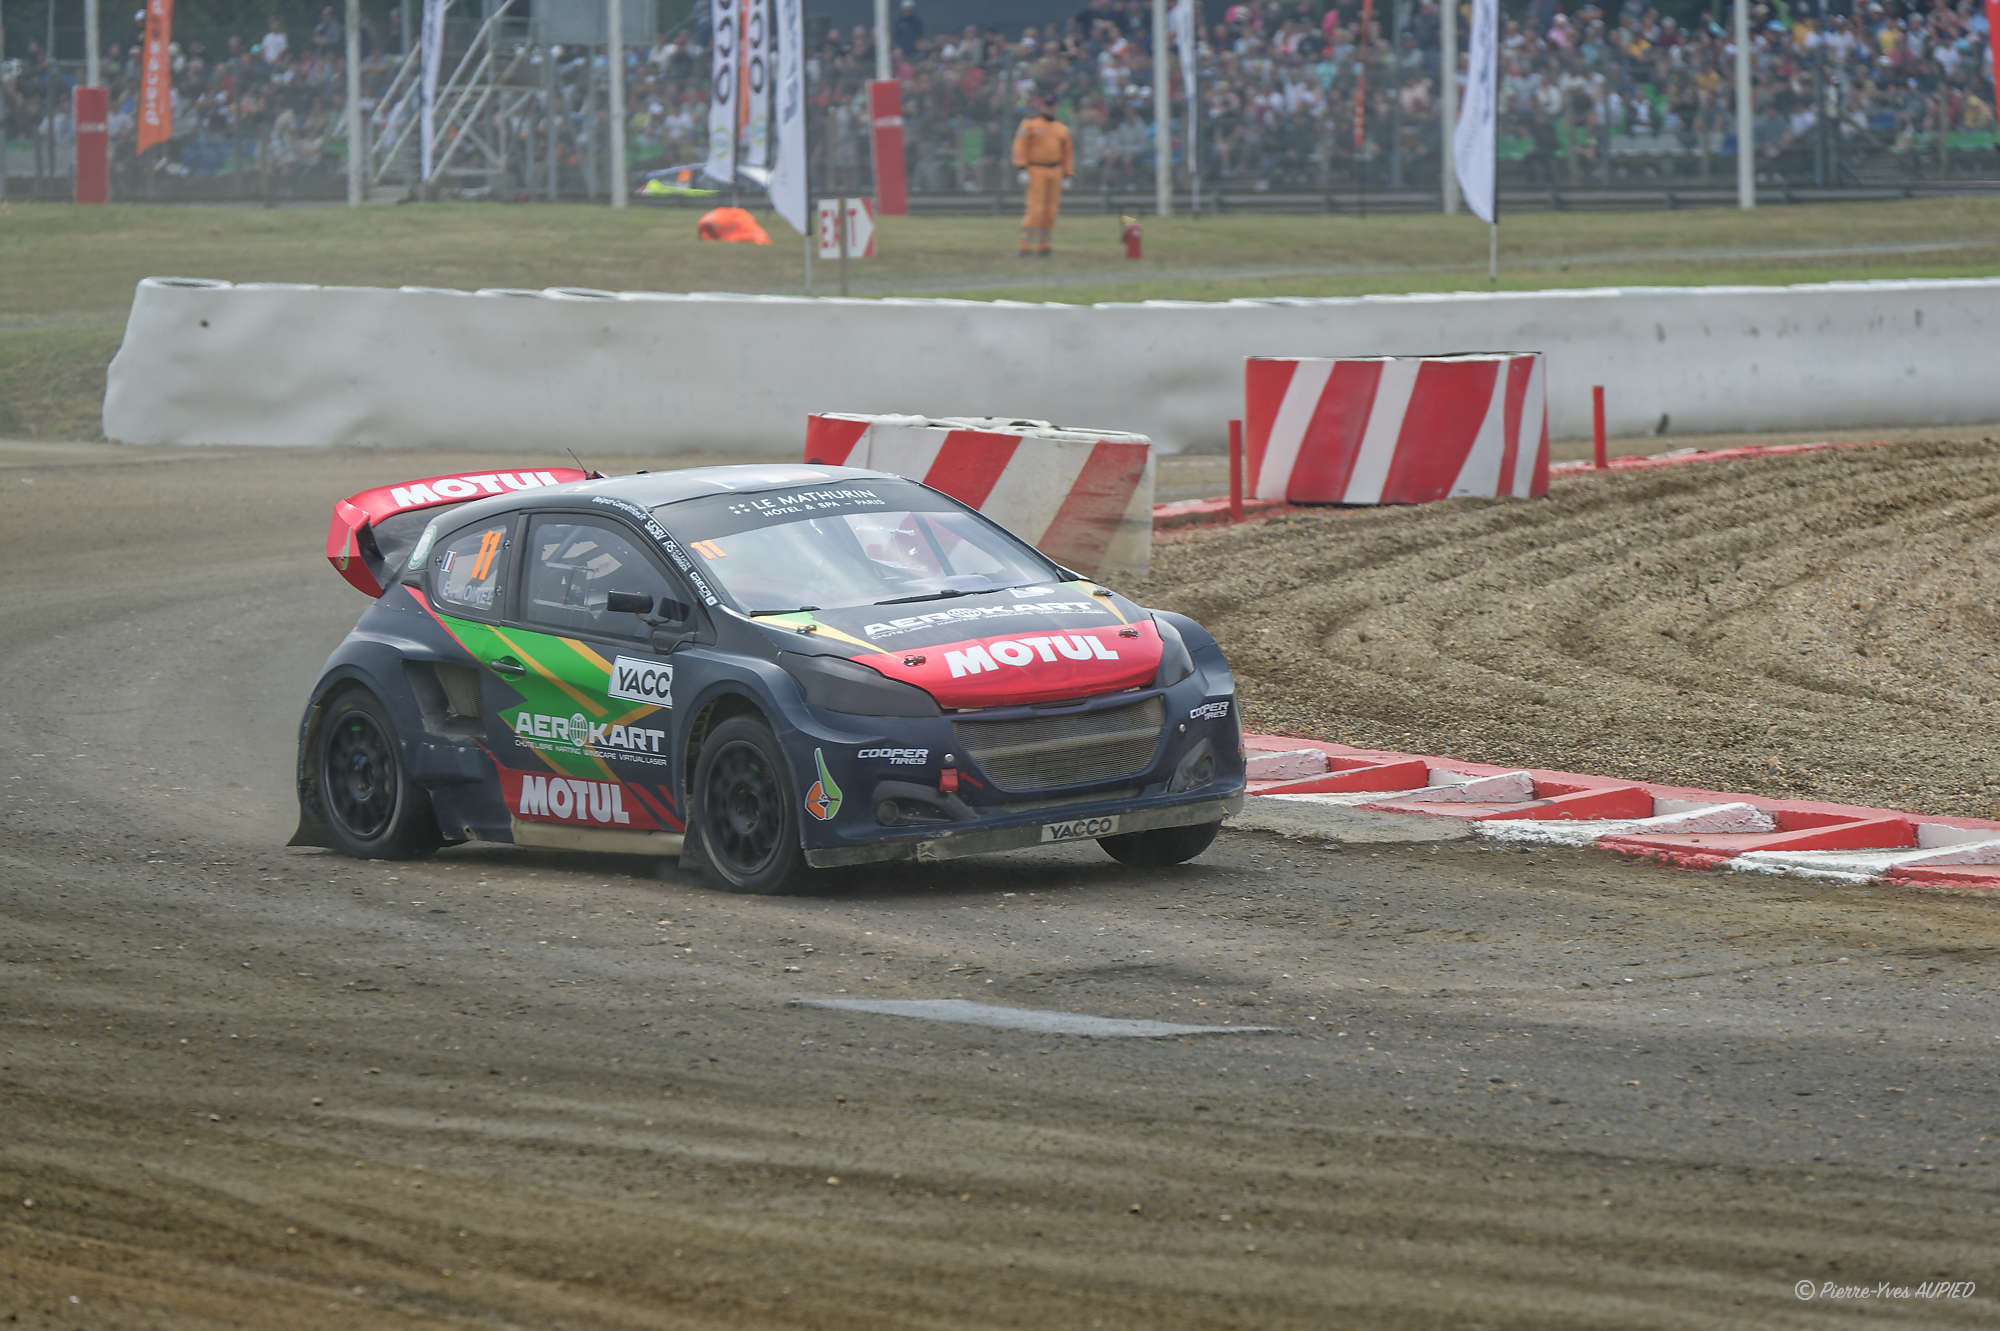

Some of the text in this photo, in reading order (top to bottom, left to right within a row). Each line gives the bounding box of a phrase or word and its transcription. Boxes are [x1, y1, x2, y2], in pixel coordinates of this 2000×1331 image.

[820, 208, 857, 249] EXT
[751, 489, 877, 511] LE MATHURIN
[805, 503, 815, 512] &
[817, 500, 840, 510] SPA
[471, 529, 503, 581] 11
[690, 539, 728, 560] 11
[944, 635, 1119, 679] MOTUL
[618, 666, 672, 698] YACC
[1190, 701, 1230, 719] COOPER
[857, 748, 929, 759] COOPER
[889, 757, 927, 765] TIRES
[520, 775, 630, 825] MOTUL
[1050, 818, 1113, 839] YACCO
